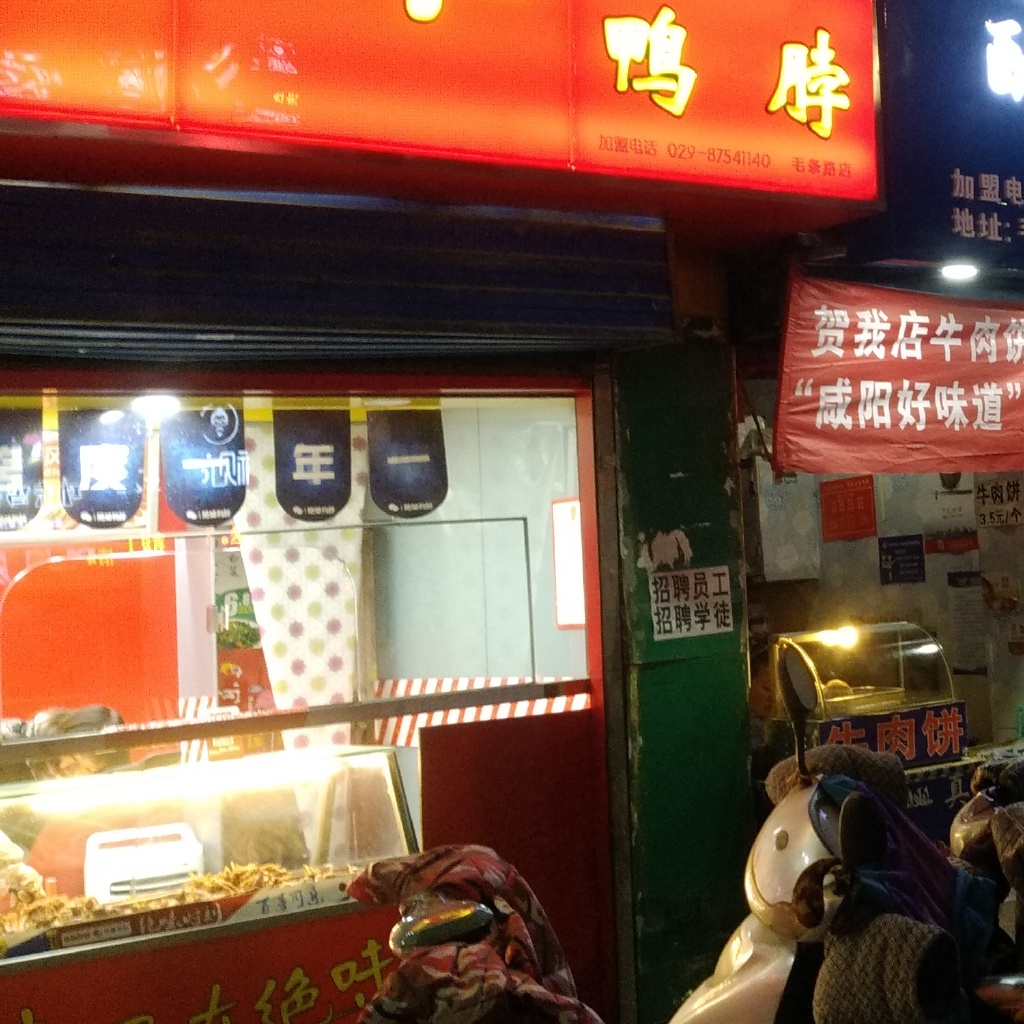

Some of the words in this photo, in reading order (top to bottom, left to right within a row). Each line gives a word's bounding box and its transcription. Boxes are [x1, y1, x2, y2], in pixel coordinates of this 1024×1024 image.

[602, 4, 851, 139] 鸭脖
[598, 134, 658, 157] 加盟电话
[667, 143, 771, 169] 029-87541140
[791, 156, 852, 177] 毛条路店
[977, 480, 1021, 506] 牛肉饼
[652, 572, 729, 604] 招聘员工
[654, 601, 731, 635] 招聘学徒
